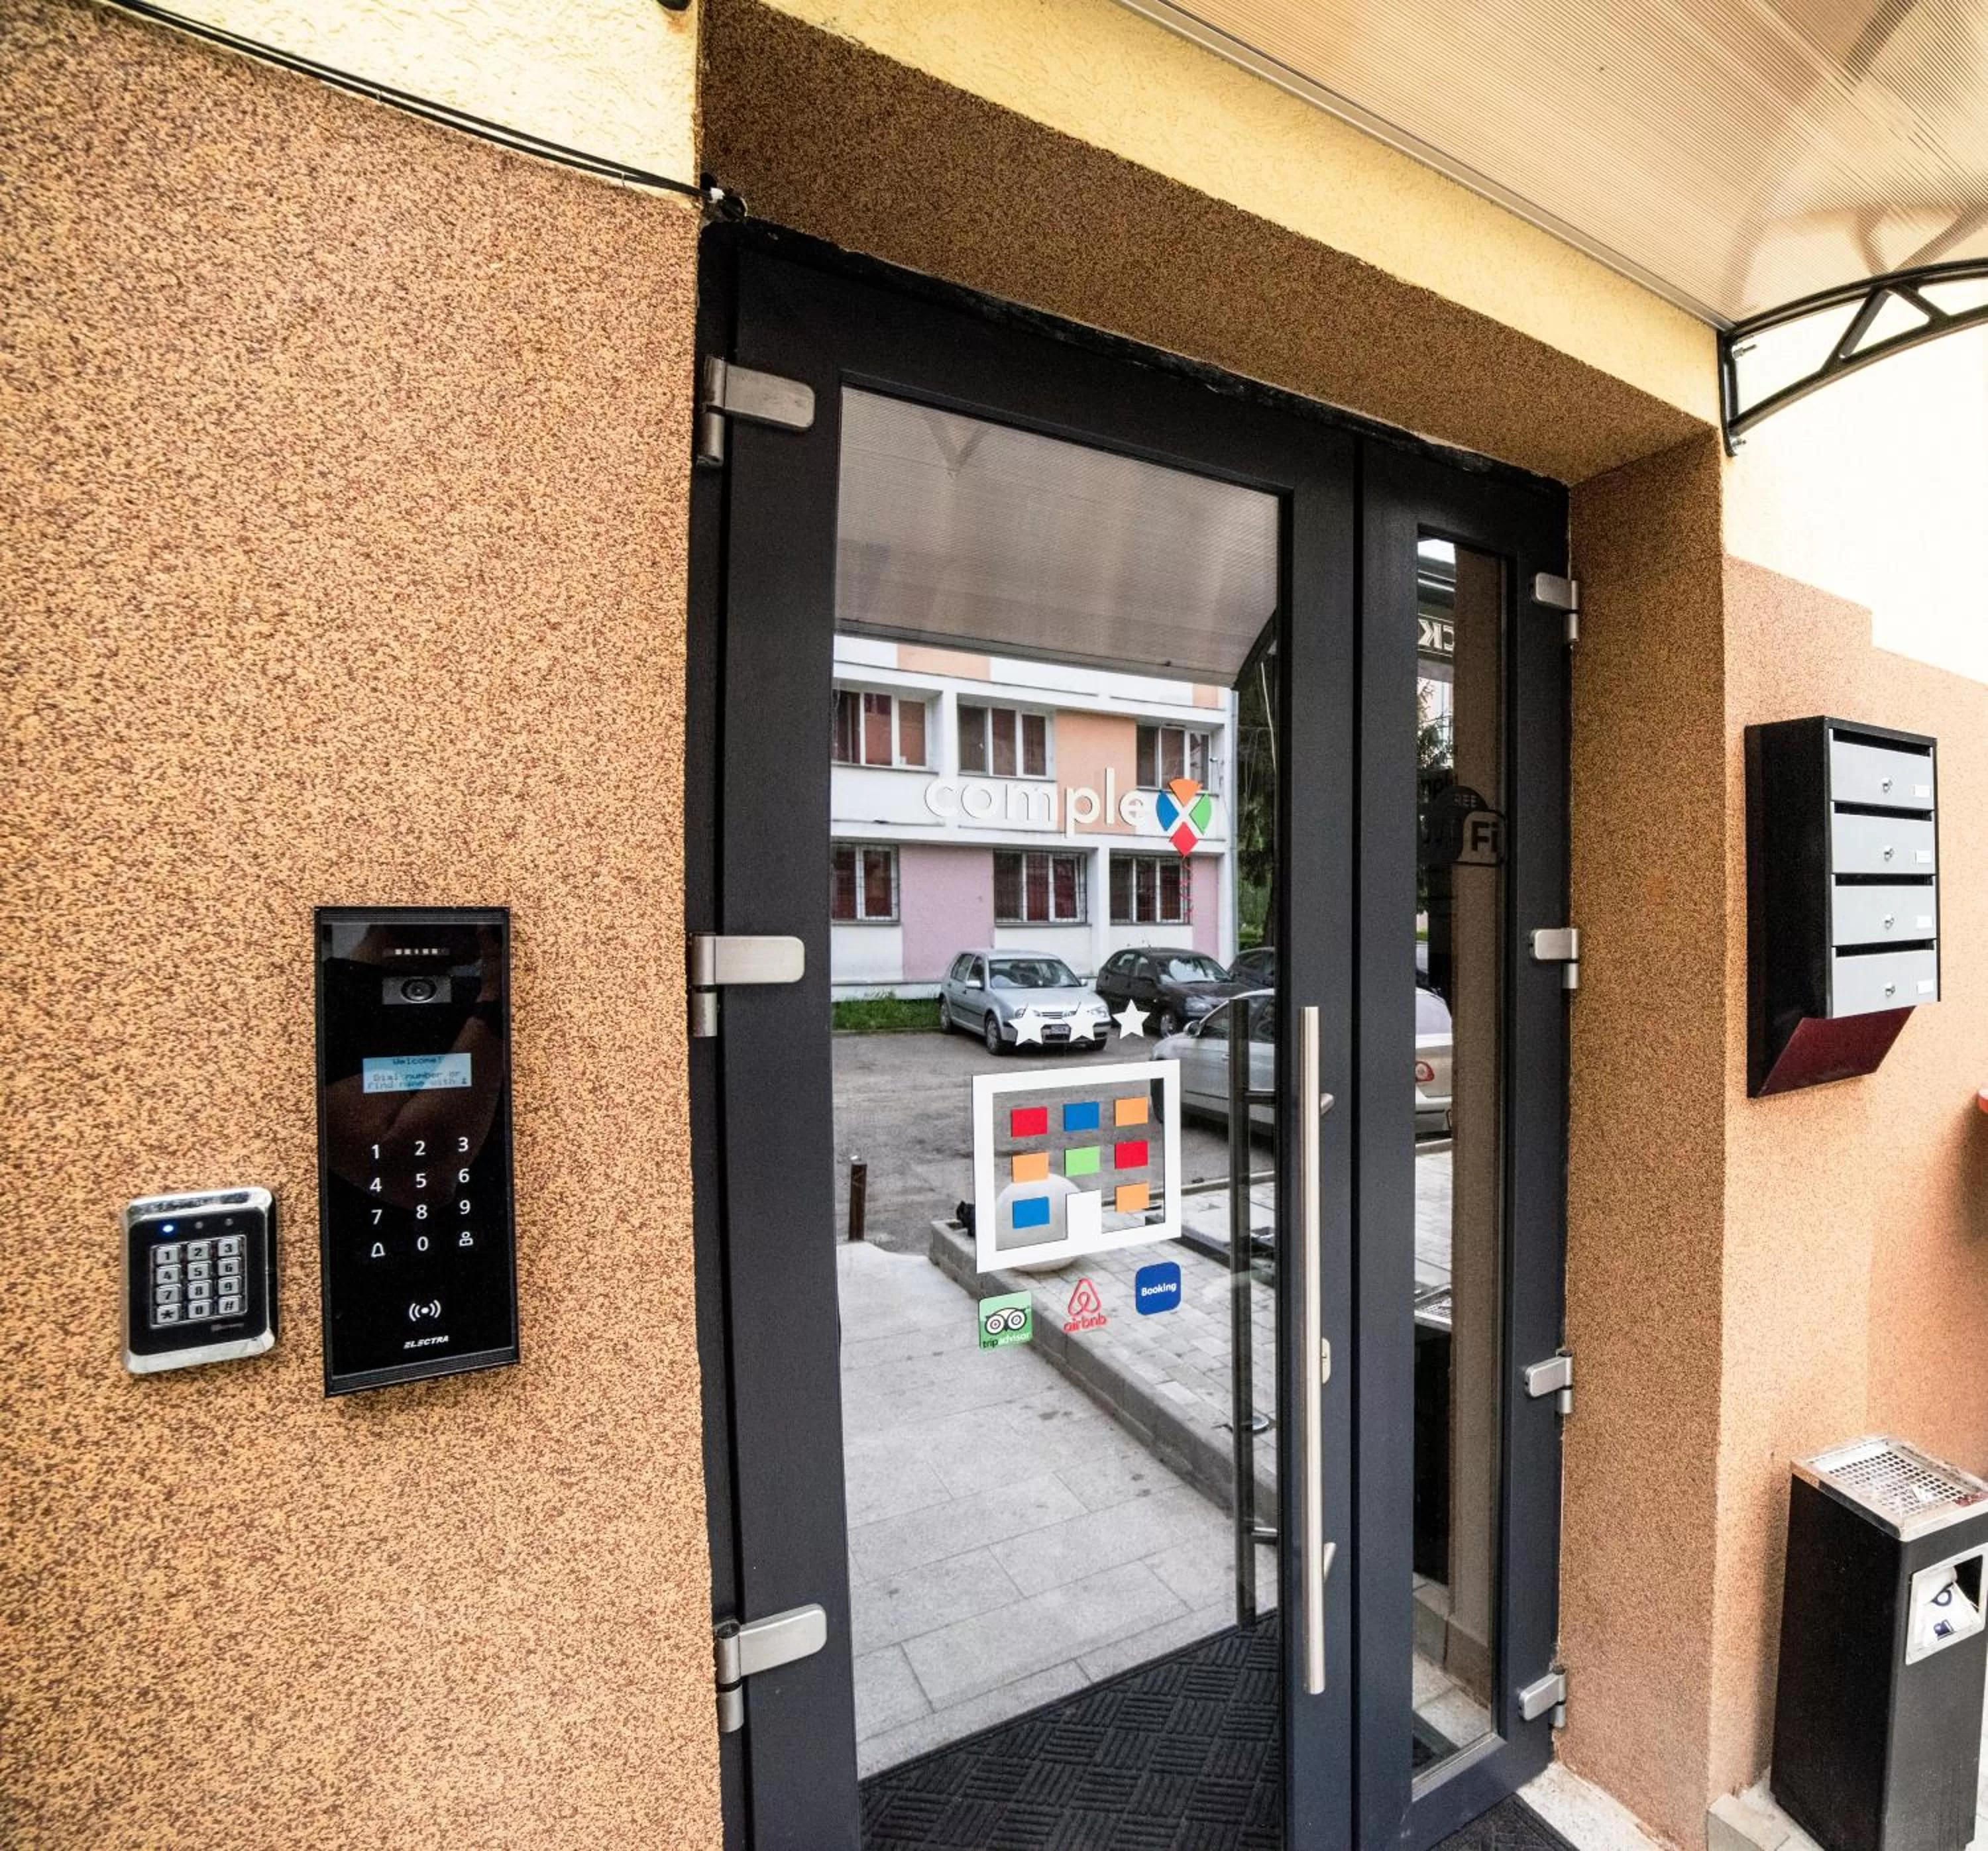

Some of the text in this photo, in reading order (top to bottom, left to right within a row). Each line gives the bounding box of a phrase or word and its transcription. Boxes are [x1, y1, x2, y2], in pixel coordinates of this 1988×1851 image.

[371, 1136, 469, 1159] 1 2 3
[369, 1168, 470, 1192] 4 5 6
[371, 1199, 470, 1225] 7 8 9
[164, 1243, 233, 1260] 1 2 3
[417, 1236, 429, 1251] 0
[163, 1263, 233, 1280] 4 5 6
[164, 1283, 233, 1300] 7 8 9
[1141, 1281, 1177, 1296] Booking
[195, 1305, 203, 1315] 0
[1063, 1312, 1108, 1334] airbnb
[404, 1335, 449, 1349] ELECTRA
